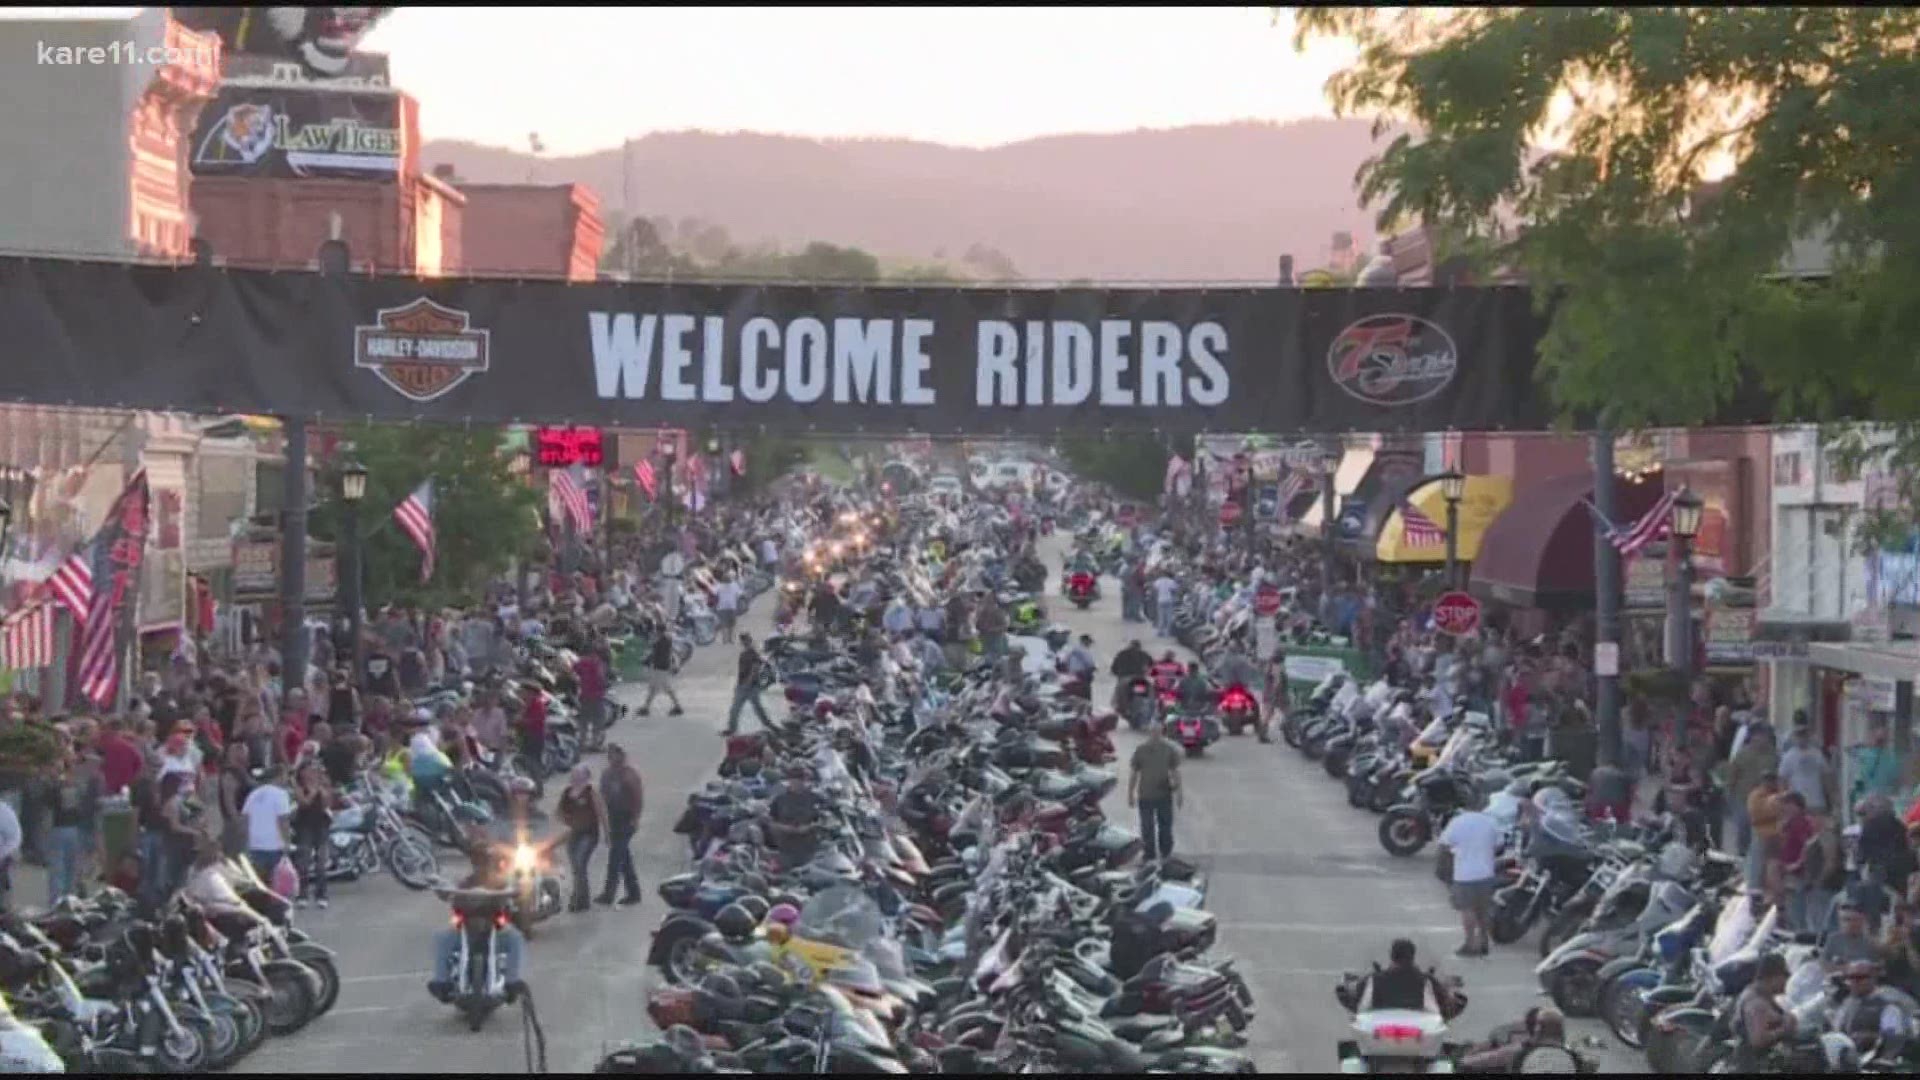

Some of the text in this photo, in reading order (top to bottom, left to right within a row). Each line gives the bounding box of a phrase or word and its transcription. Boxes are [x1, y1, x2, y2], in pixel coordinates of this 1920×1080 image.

[589, 312, 1230, 406] WELCOME RIDERS
[1436, 606, 1475, 622] STOP
